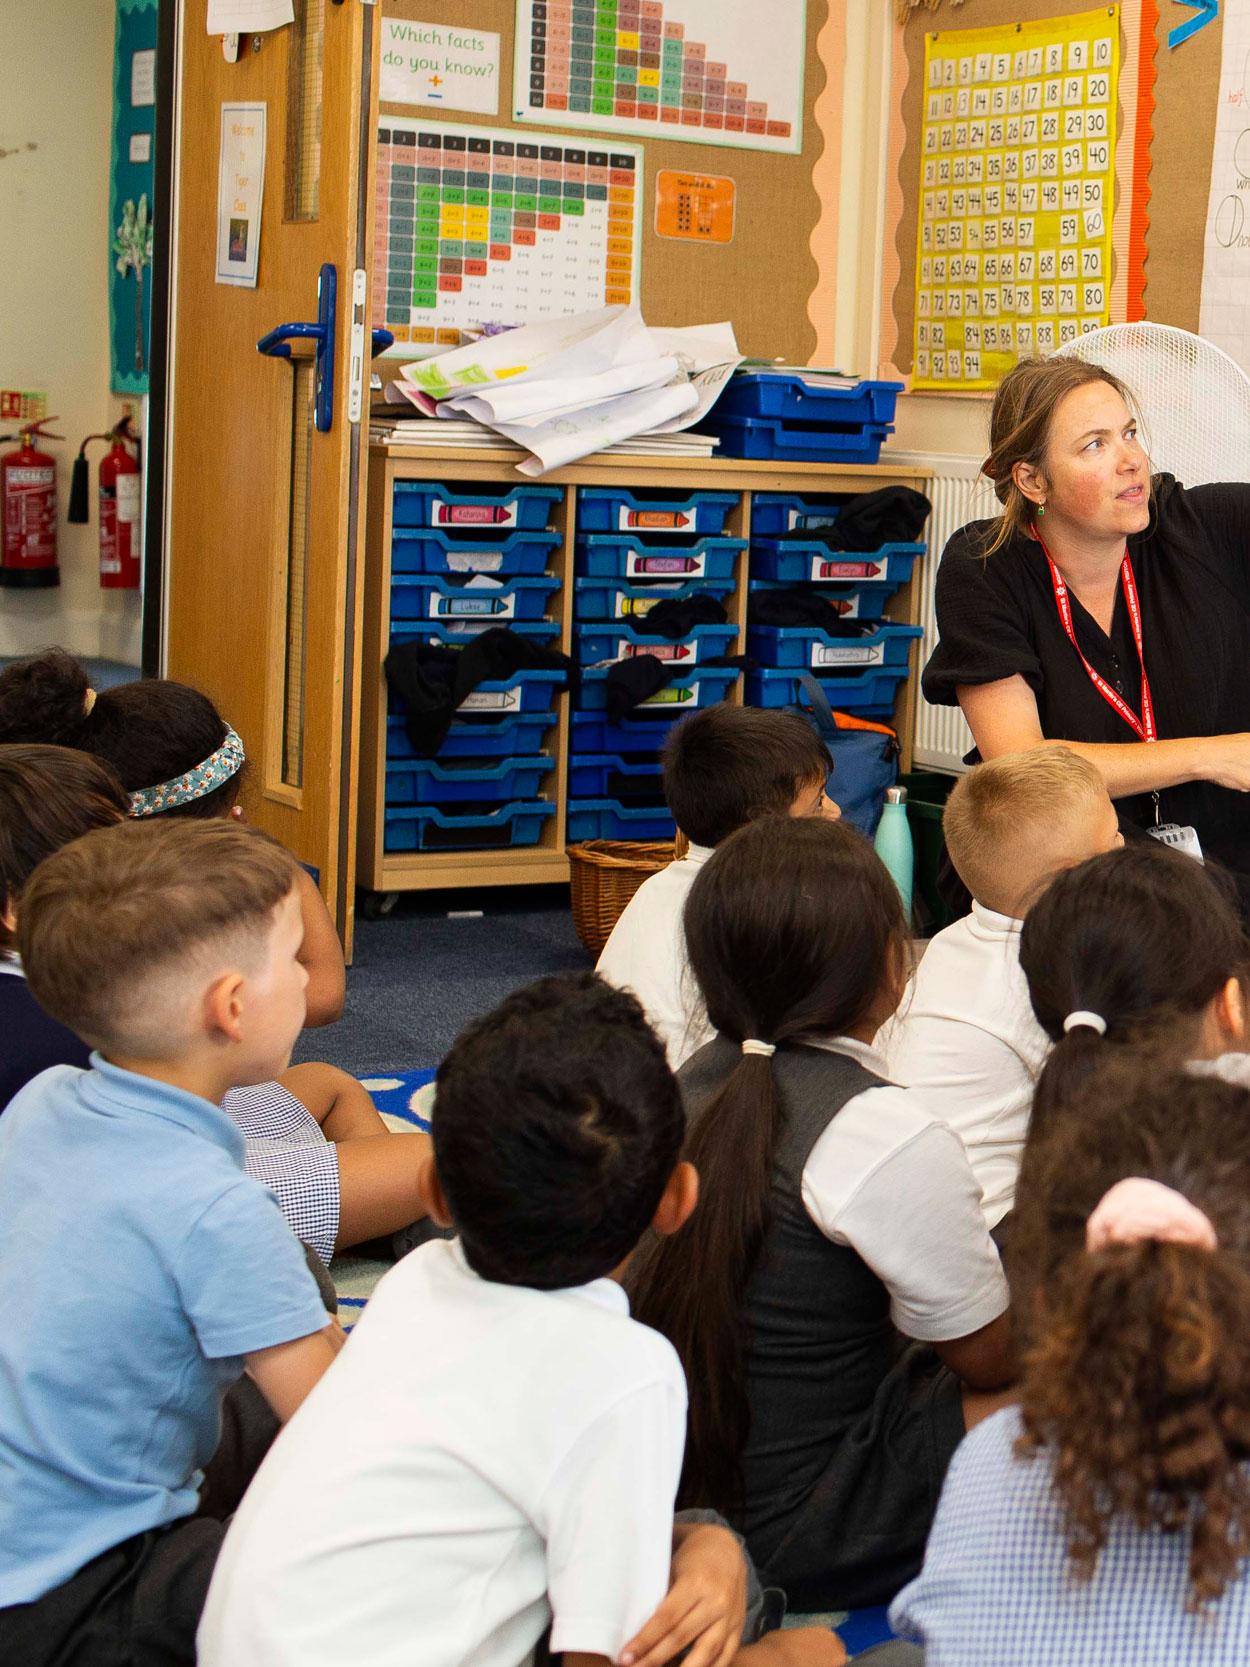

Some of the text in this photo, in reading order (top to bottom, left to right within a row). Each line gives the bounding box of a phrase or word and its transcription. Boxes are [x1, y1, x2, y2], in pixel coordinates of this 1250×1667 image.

[390, 24, 484, 51] Which facts
[383, 50, 494, 77] do you know?
[998, 43, 1107, 75] 5 6 7 8 9 10
[994, 80, 1106, 108] 15 16 17 18 19 20
[1228, 88, 1245, 107] half
[990, 114, 1104, 141] 25 26 27 28 29 30
[1025, 147, 1107, 172] 37 38 39 40
[986, 184, 1100, 207] 45 47 48 49 50
[985, 213, 1101, 242] 55 57 59 60
[985, 254, 1098, 275] 65 67 68 69 70
[985, 288, 1102, 309] 75 78 58 79 80
[965, 327, 979, 342] 84
[965, 356, 979, 372] 94
[1101, 685, 1117, 702] Martin's
[1115, 700, 1123, 708] CE
[1121, 706, 1136, 724] Primary
